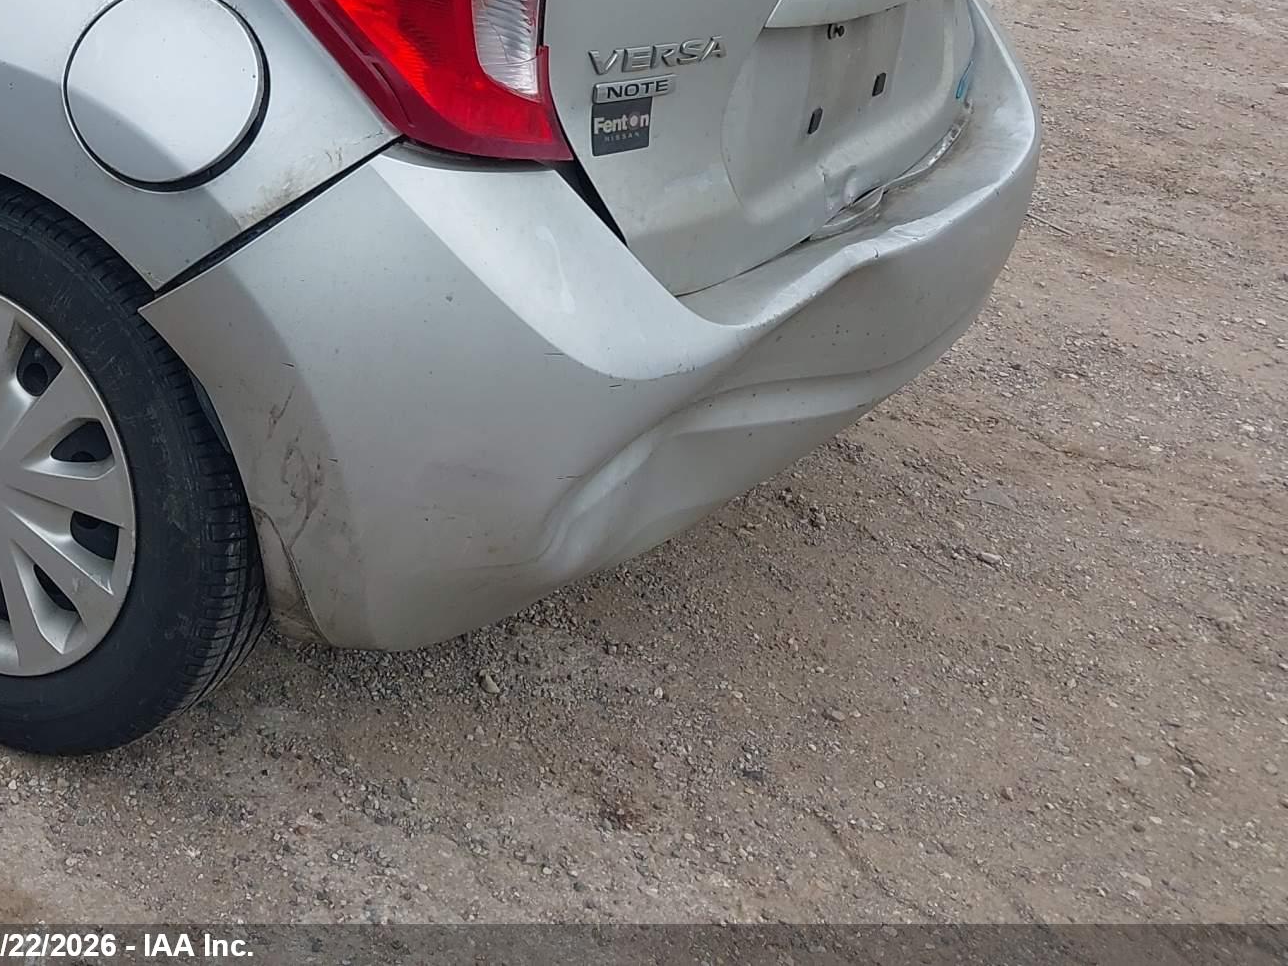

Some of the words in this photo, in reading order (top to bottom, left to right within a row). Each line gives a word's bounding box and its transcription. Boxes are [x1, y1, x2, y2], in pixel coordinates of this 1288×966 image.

[587, 35, 728, 76] VERSA
[607, 79, 669, 99] NOTE
[593, 112, 650, 135] Fenton
